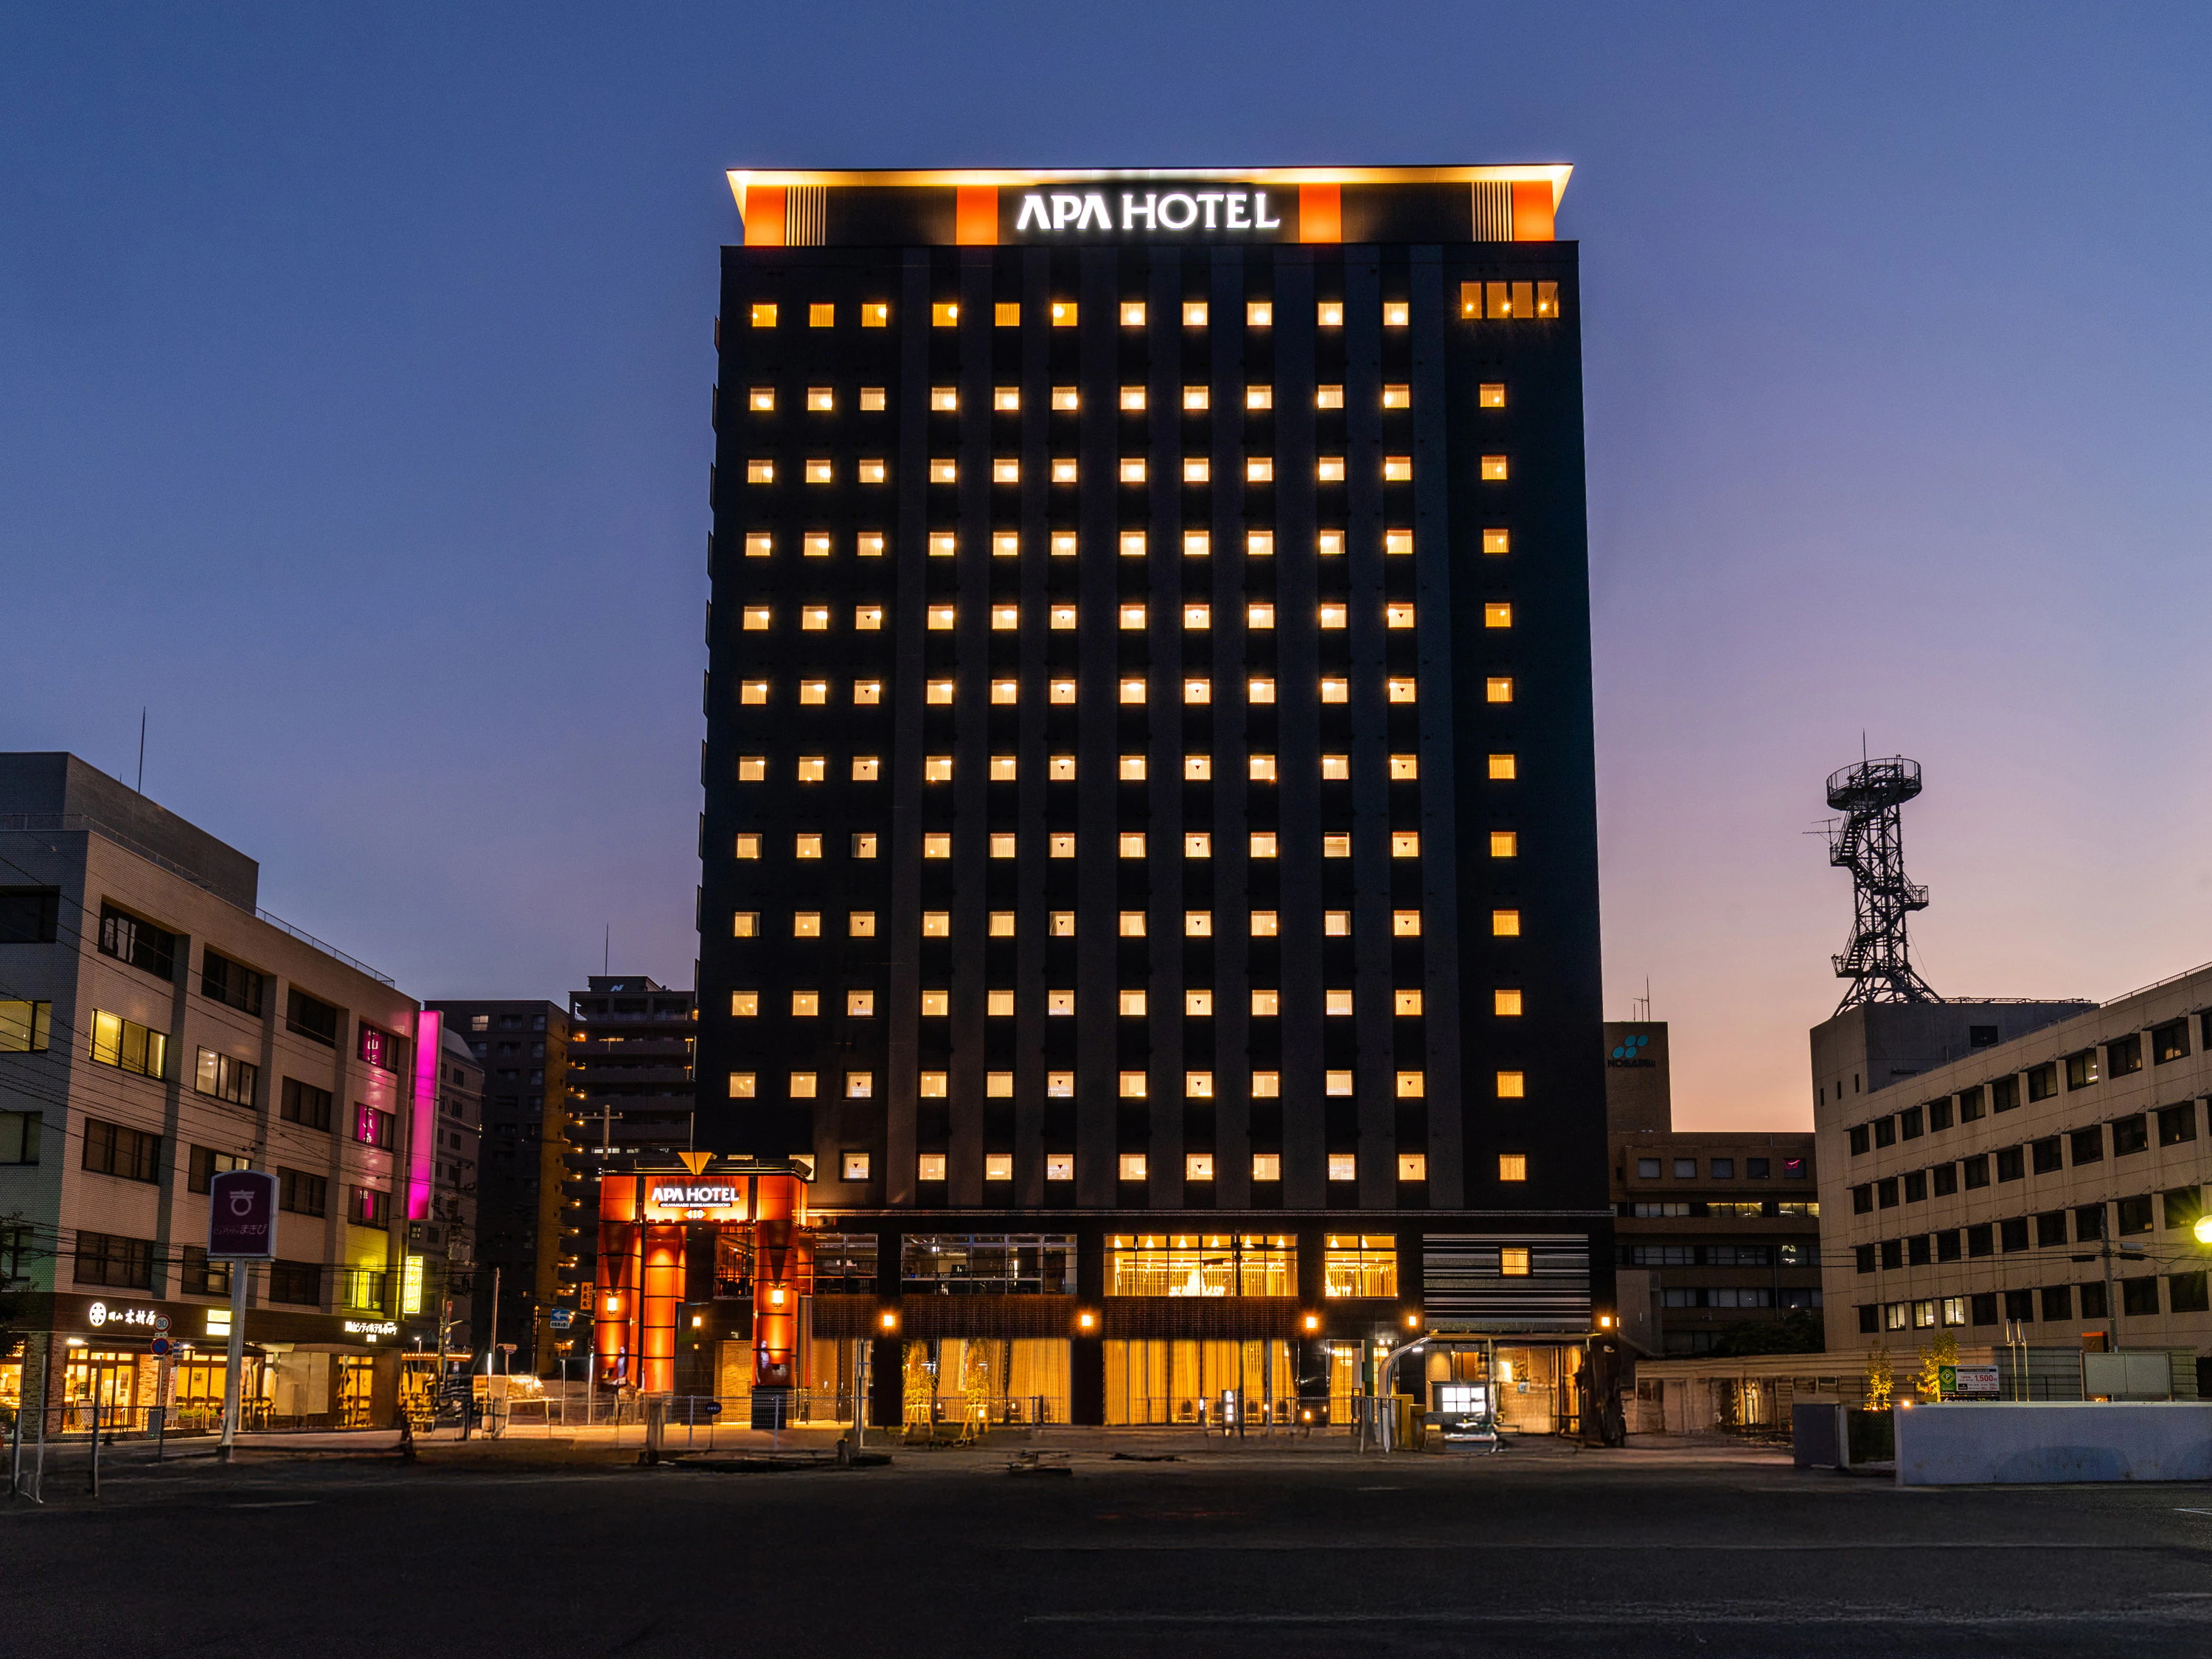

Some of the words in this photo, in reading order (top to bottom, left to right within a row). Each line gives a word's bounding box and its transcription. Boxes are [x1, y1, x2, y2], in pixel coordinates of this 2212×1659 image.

[1017, 195, 1112, 230] APA
[1122, 193, 1280, 230] HOTEL
[651, 1187, 684, 1201] APA
[686, 1187, 740, 1202] HOTEL
[686, 1210, 703, 1219] 410
[108, 1312, 123, 1321] 岡山
[125, 1309, 156, 1326] 木村屋
[156, 1319, 167, 1327] 30
